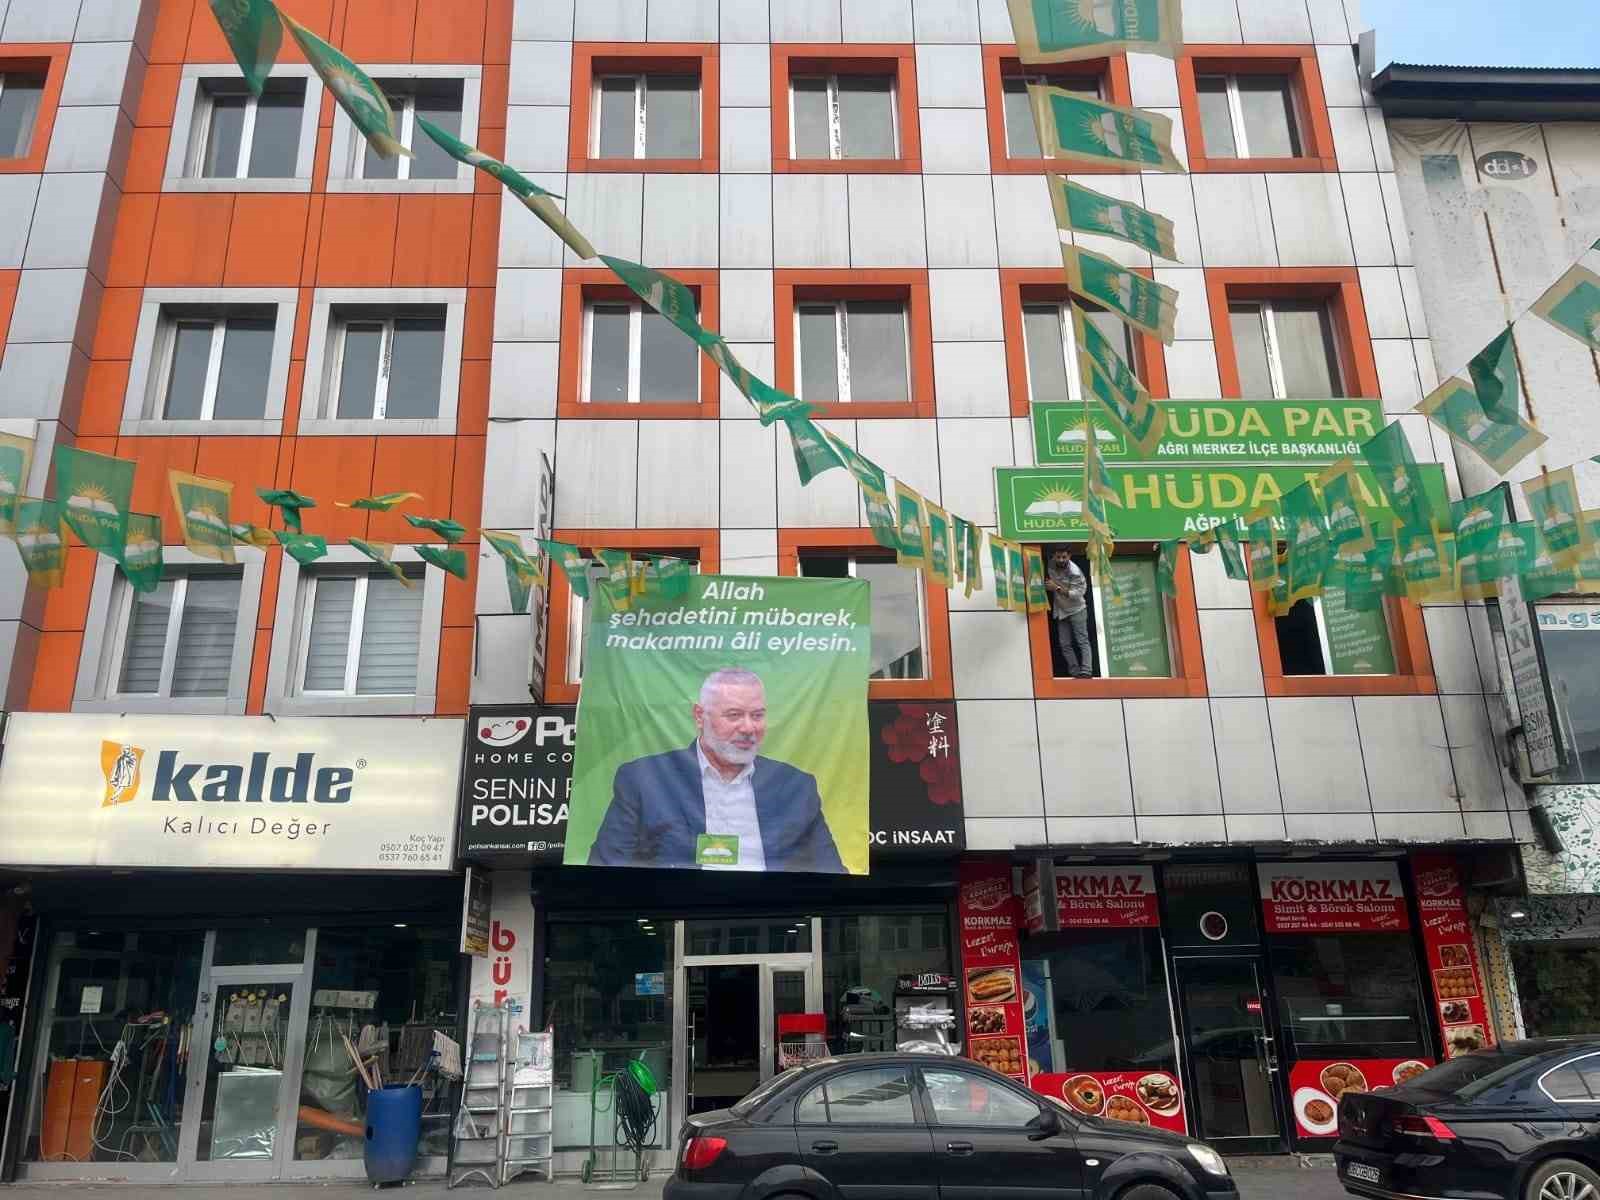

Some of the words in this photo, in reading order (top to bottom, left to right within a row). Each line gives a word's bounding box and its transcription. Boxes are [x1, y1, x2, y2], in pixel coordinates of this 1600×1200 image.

[1165, 407, 1271, 437] ÜDA
[1282, 407, 1376, 437] PAR
[1056, 444, 1087, 453] HUD
[1157, 441, 1189, 455] AĞRI
[1192, 443, 1247, 455] MERKEZ
[1249, 440, 1278, 457] İLÇE
[1281, 440, 1361, 457] BAŞKANLIĞI
[1123, 473, 1282, 509] HÜDA
[702, 581, 765, 600] Allah
[608, 606, 737, 629] şehadetini
[743, 608, 858, 630] mübarek,
[606, 632, 725, 651] makamını
[731, 631, 761, 651] âli
[767, 633, 858, 656] eylesin.
[926, 712, 951, 760] 塗料
[474, 752, 534, 764] HOME
[151, 749, 354, 804] kalde
[163, 816, 241, 835] Kalıcı
[250, 816, 332, 840] Değer
[1271, 880, 1395, 902] KORKMAZ
[1106, 899, 1145, 909] Salonu
[1274, 903, 1305, 914] Simit
[1308, 903, 1317, 913] &
[1320, 902, 1354, 913] Börek
[1356, 901, 1396, 913] Salonu
[964, 916, 1013, 926] KORKMAZ
